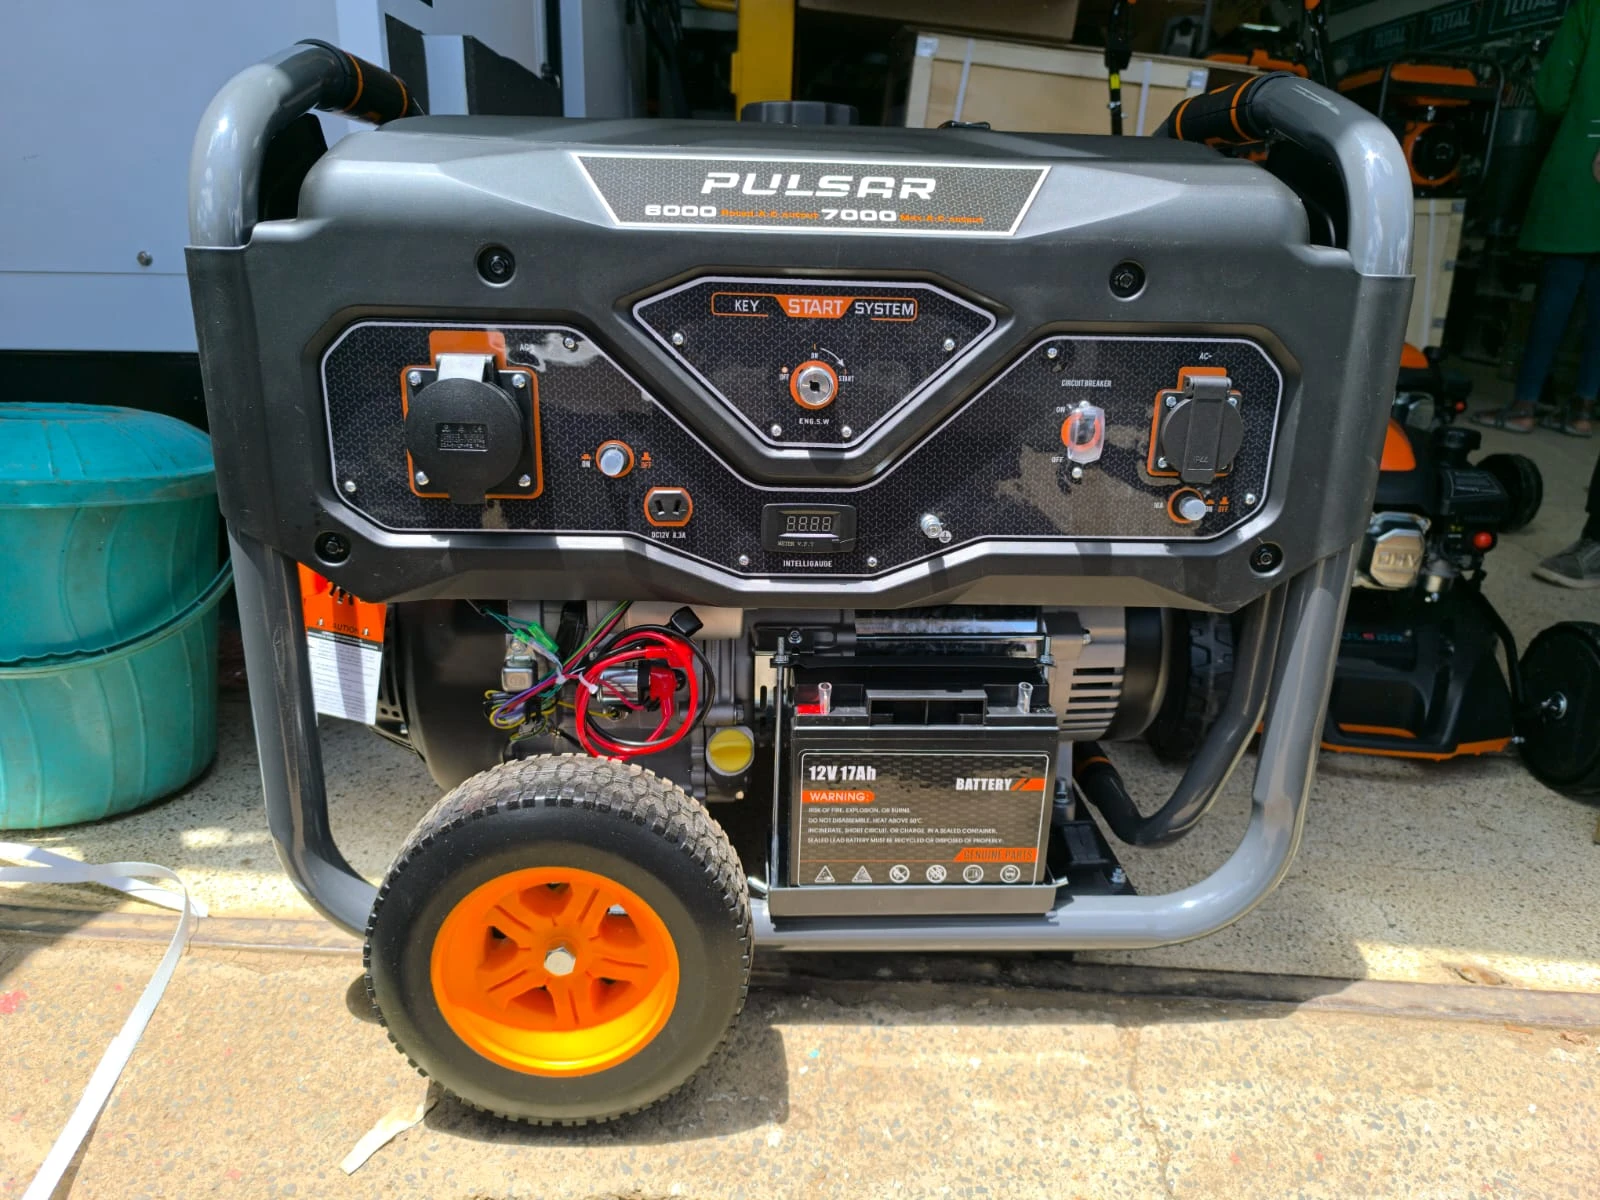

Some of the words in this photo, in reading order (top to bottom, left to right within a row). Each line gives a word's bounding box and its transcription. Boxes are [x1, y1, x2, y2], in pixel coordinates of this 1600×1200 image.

[700, 171, 936, 200] PULSAR
[644, 204, 716, 217] 6000
[821, 208, 897, 222] 7000
[734, 298, 759, 312] KEY
[787, 298, 845, 316] START
[854, 300, 915, 317] SYSTEM
[808, 765, 838, 781] 12V
[840, 764, 876, 782] 17Ah
[956, 777, 1012, 792] BATTERY
[810, 792, 870, 802] WARNING:
[1006, 850, 1033, 860] PARTS
